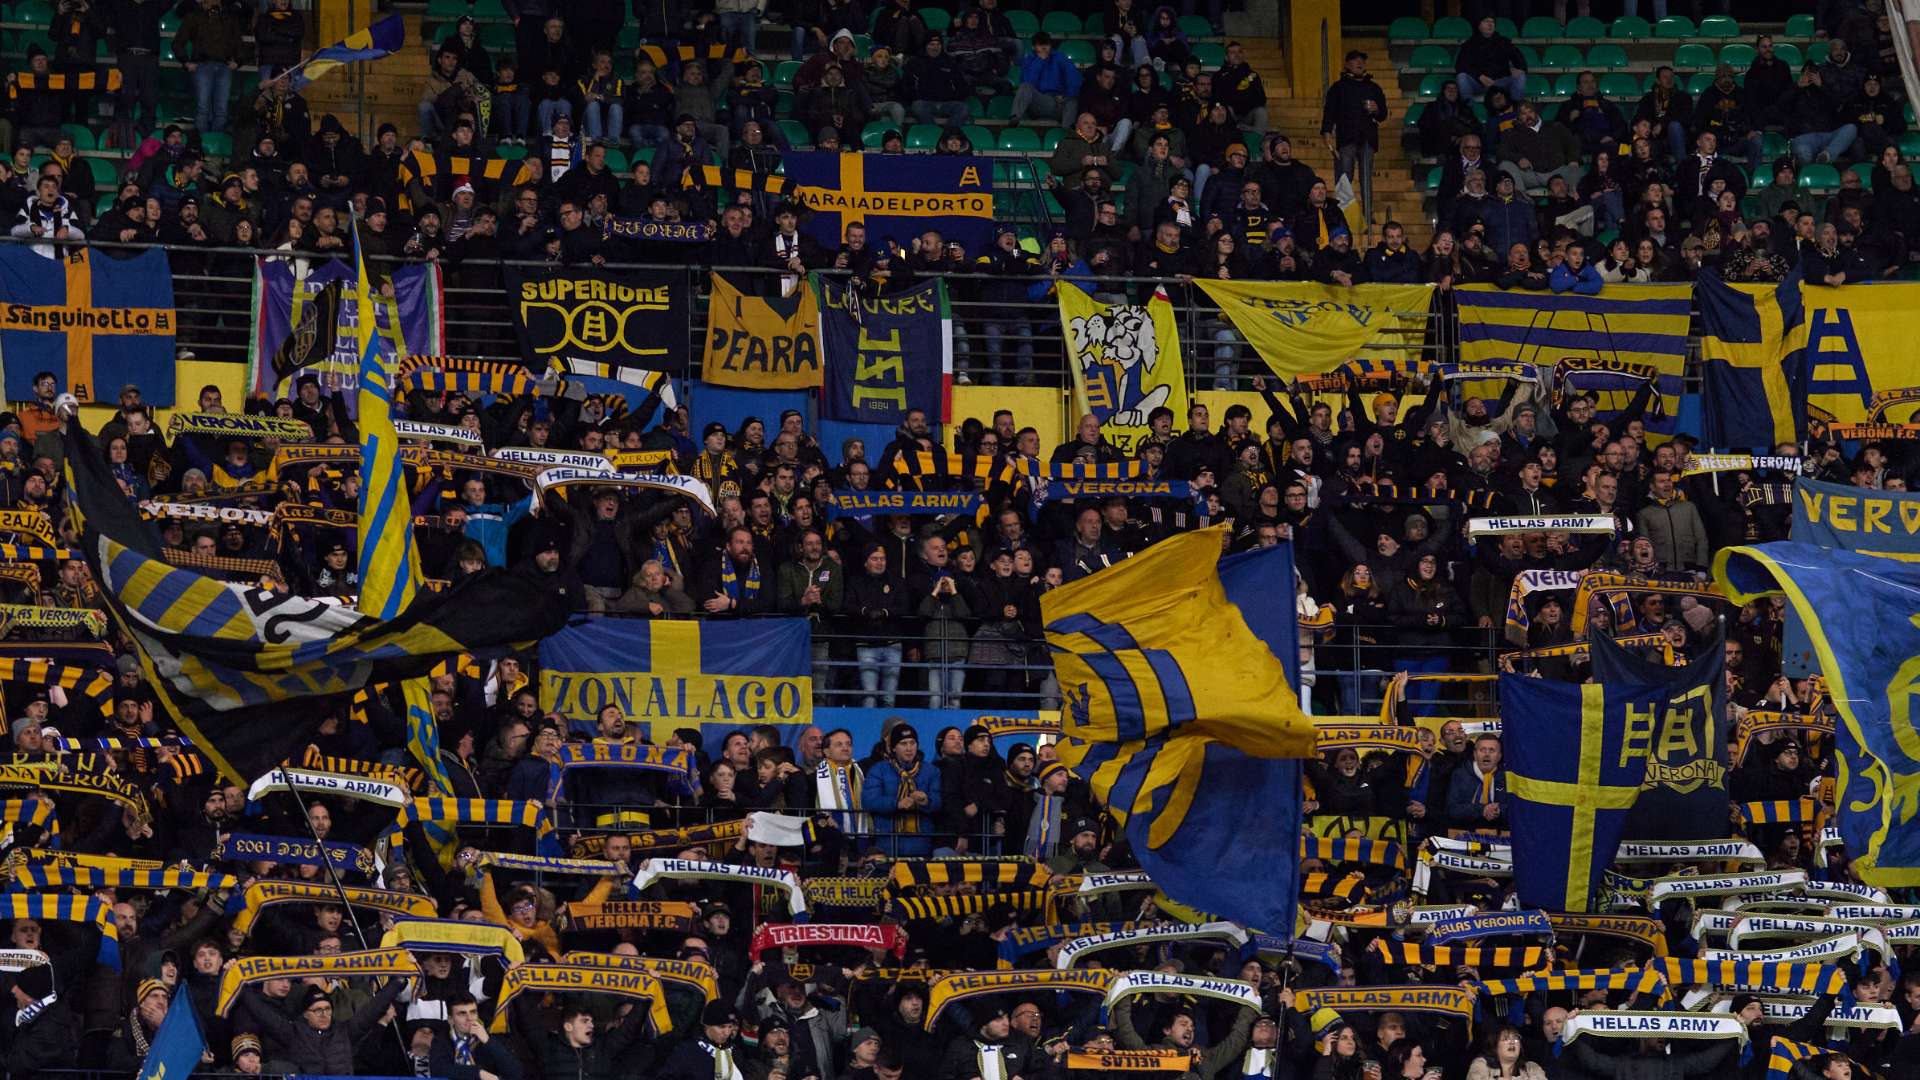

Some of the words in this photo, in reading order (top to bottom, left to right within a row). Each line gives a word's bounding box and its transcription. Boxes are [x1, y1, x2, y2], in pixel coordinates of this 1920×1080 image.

[183, 414, 262, 431] VERONA
[393, 421, 445, 435] HELLAS
[451, 428, 481, 440] ARM
[1842, 428, 1893, 439] VERONA
[501, 451, 549, 463] HELLAS
[553, 454, 604, 468] ARMY
[1752, 457, 1801, 472] VERONA
[547, 470, 625, 483] HELLAS
[632, 473, 693, 487] ARMY
[1063, 482, 1171, 495] VERONA
[838, 494, 906, 509] ELLAS
[912, 495, 974, 509] ARMY
[1801, 487, 1920, 533] VERO
[147, 503, 271, 523] VERON
[1488, 518, 1545, 529] HELLAS
[1551, 518, 1594, 528] ARMY
[1526, 570, 1581, 588] VERO
[39, 609, 87, 620] VERONA
[1623, 636, 1667, 651] RMY
[551, 675, 801, 720] ZONALAGO
[1316, 728, 1362, 743] LLAS
[570, 743, 689, 771] ERONA
[1647, 761, 1719, 783] VERONA
[271, 772, 338, 788] HELLAS
[345, 781, 393, 798] ARMY
[1626, 844, 1689, 856] HELLAS
[1696, 843, 1743, 855] ARMY
[1438, 853, 1501, 870] HELLAS
[664, 860, 730, 874] HELLAS
[739, 866, 789, 881] ARMY
[1091, 875, 1151, 888] HELLA
[1671, 879, 1733, 892] HELLAS
[1739, 874, 1782, 887] ARMY
[1831, 881, 1878, 898] ARMY
[260, 882, 340, 900] HELLAS
[355, 891, 416, 910] ARMY
[839, 886, 882, 900] HELLA
[602, 902, 661, 914] HELLAS
[1419, 908, 1466, 921] ARMY
[1837, 907, 1903, 919] HELLAS
[584, 915, 649, 929] VERONA
[1434, 919, 1471, 938] HELLAS
[1474, 914, 1525, 930] VERONA
[1528, 914, 1543, 926] FC
[1750, 919, 1815, 932] HELLAS
[769, 924, 884, 944] TRIESTINA
[1012, 922, 1112, 946] HELLAS
[1064, 929, 1136, 956] HELLAS
[1146, 922, 1201, 936] ARMY
[1886, 925, 1920, 938] ARM
[1790, 940, 1838, 958] ARMY
[239, 956, 328, 977] HELLAS
[334, 952, 399, 969] ARMY
[506, 967, 583, 989] HELLAS
[591, 972, 654, 992] ARMY
[949, 971, 1039, 993] HELLAS
[1049, 969, 1112, 988] ARMY
[1127, 973, 1194, 987] HELLAS
[1201, 980, 1250, 998] ARMY
[1306, 991, 1392, 1007] HELLAS
[1402, 992, 1463, 1008] ARMY
[1763, 1004, 1809, 1017] ELLAS
[1828, 1008, 1873, 1021] RMY
[1592, 1018, 1661, 1031] HELLAS
[1668, 1019, 1720, 1032] ARMY
[1101, 1055, 1161, 1068] HELLAS
